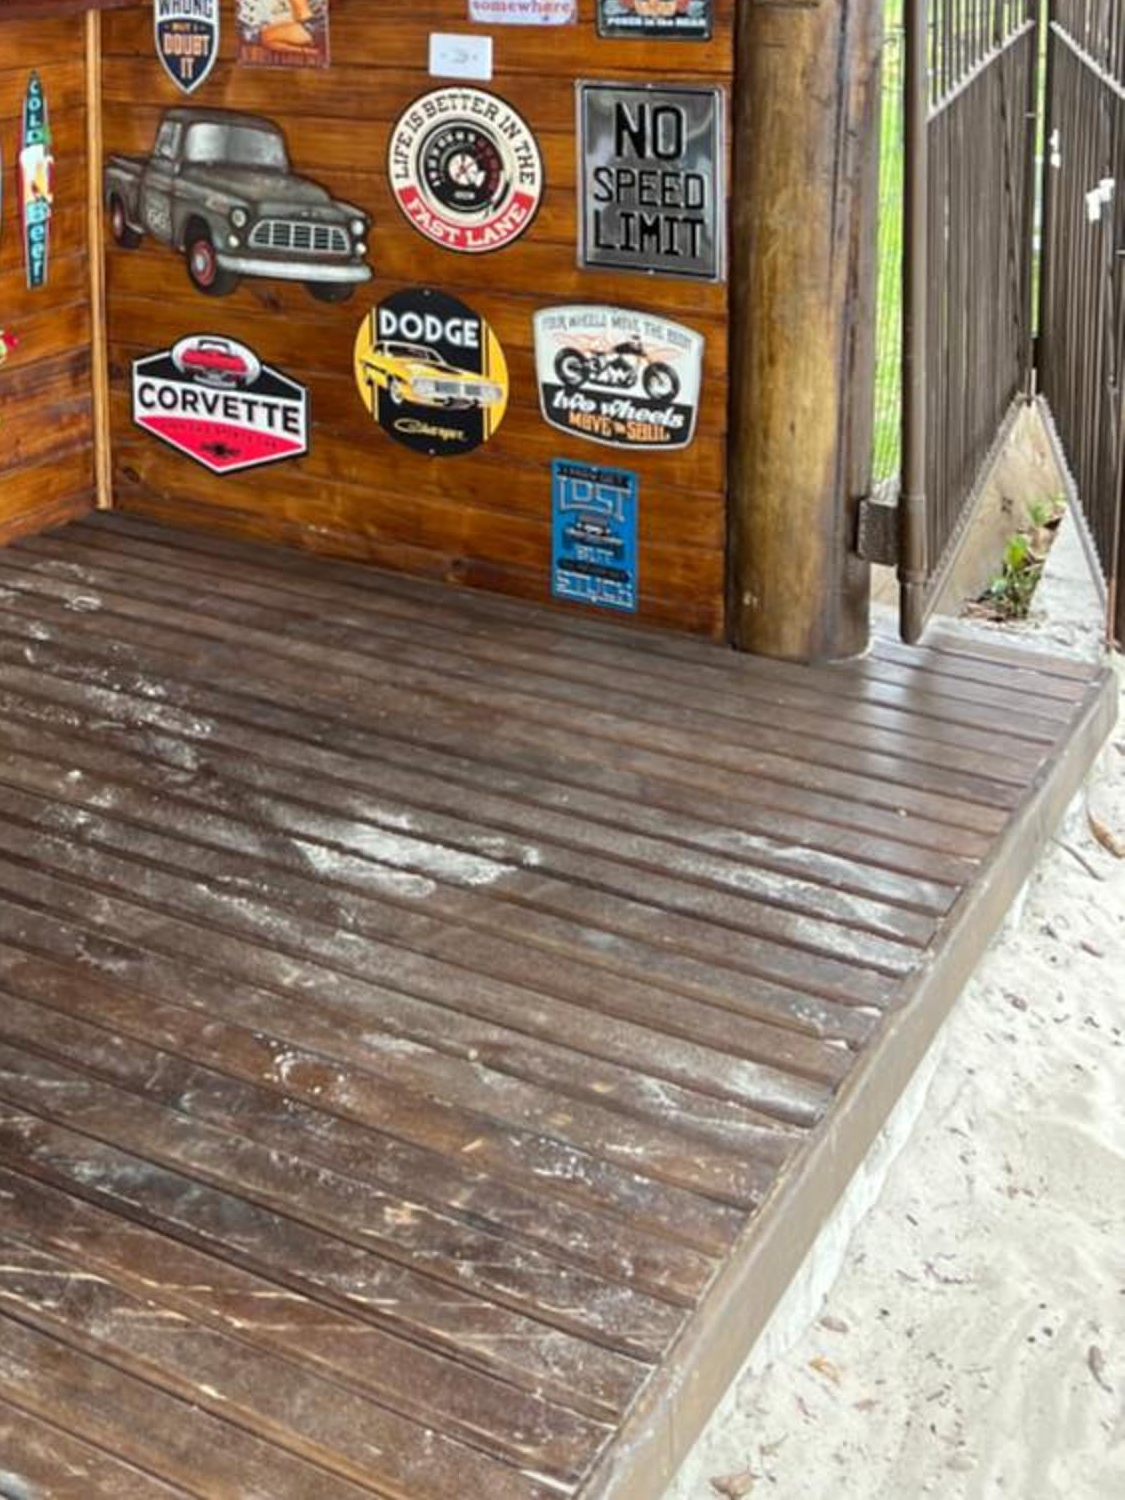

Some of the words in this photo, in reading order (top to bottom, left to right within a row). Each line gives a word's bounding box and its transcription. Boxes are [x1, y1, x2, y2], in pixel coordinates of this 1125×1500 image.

[162, 33, 211, 57] DOUBT
[180, 57, 196, 80] IT
[393, 132, 413, 180] LIFE
[404, 110, 426, 133] IS
[421, 93, 500, 123] BETTER
[498, 115, 522, 140] IN
[514, 141, 537, 186] THE
[613, 101, 688, 162] NO
[592, 165, 705, 211] SPEED
[407, 197, 462, 244] FAST
[464, 202, 528, 246] LANE
[593, 209, 705, 258] LIMIT
[378, 308, 481, 350] DODGE
[137, 381, 302, 436] CORVETTE
[600, 399, 685, 429] wheels
